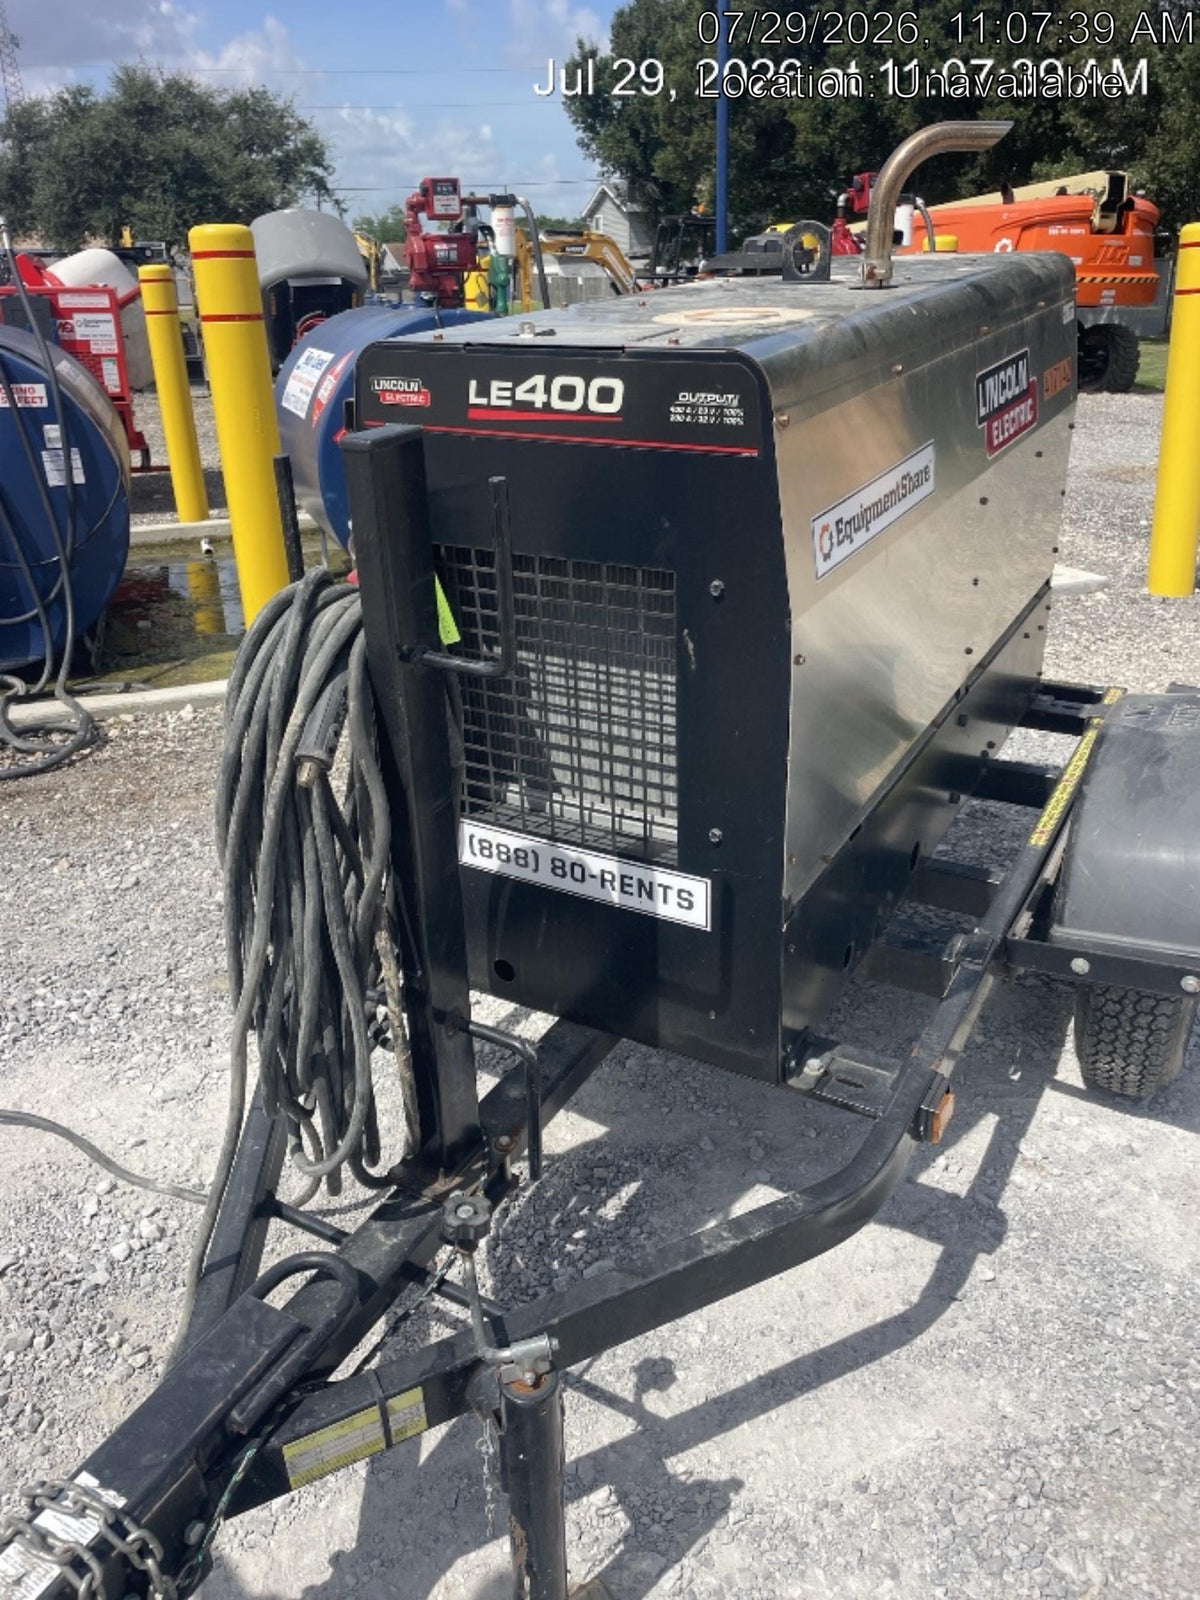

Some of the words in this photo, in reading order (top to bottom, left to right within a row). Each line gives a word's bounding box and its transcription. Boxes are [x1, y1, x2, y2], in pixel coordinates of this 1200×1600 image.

[374, 379, 419, 392] LINCOLN
[468, 374, 625, 414] LE400
[678, 391, 736, 405] OUTPUT
[979, 357, 1028, 418] LINCOLN
[992, 398, 1034, 447] ELECTRIC
[834, 464, 931, 547] EquipmentShare
[468, 833, 541, 873] (888)
[549, 858, 695, 911] 80-RENTS
